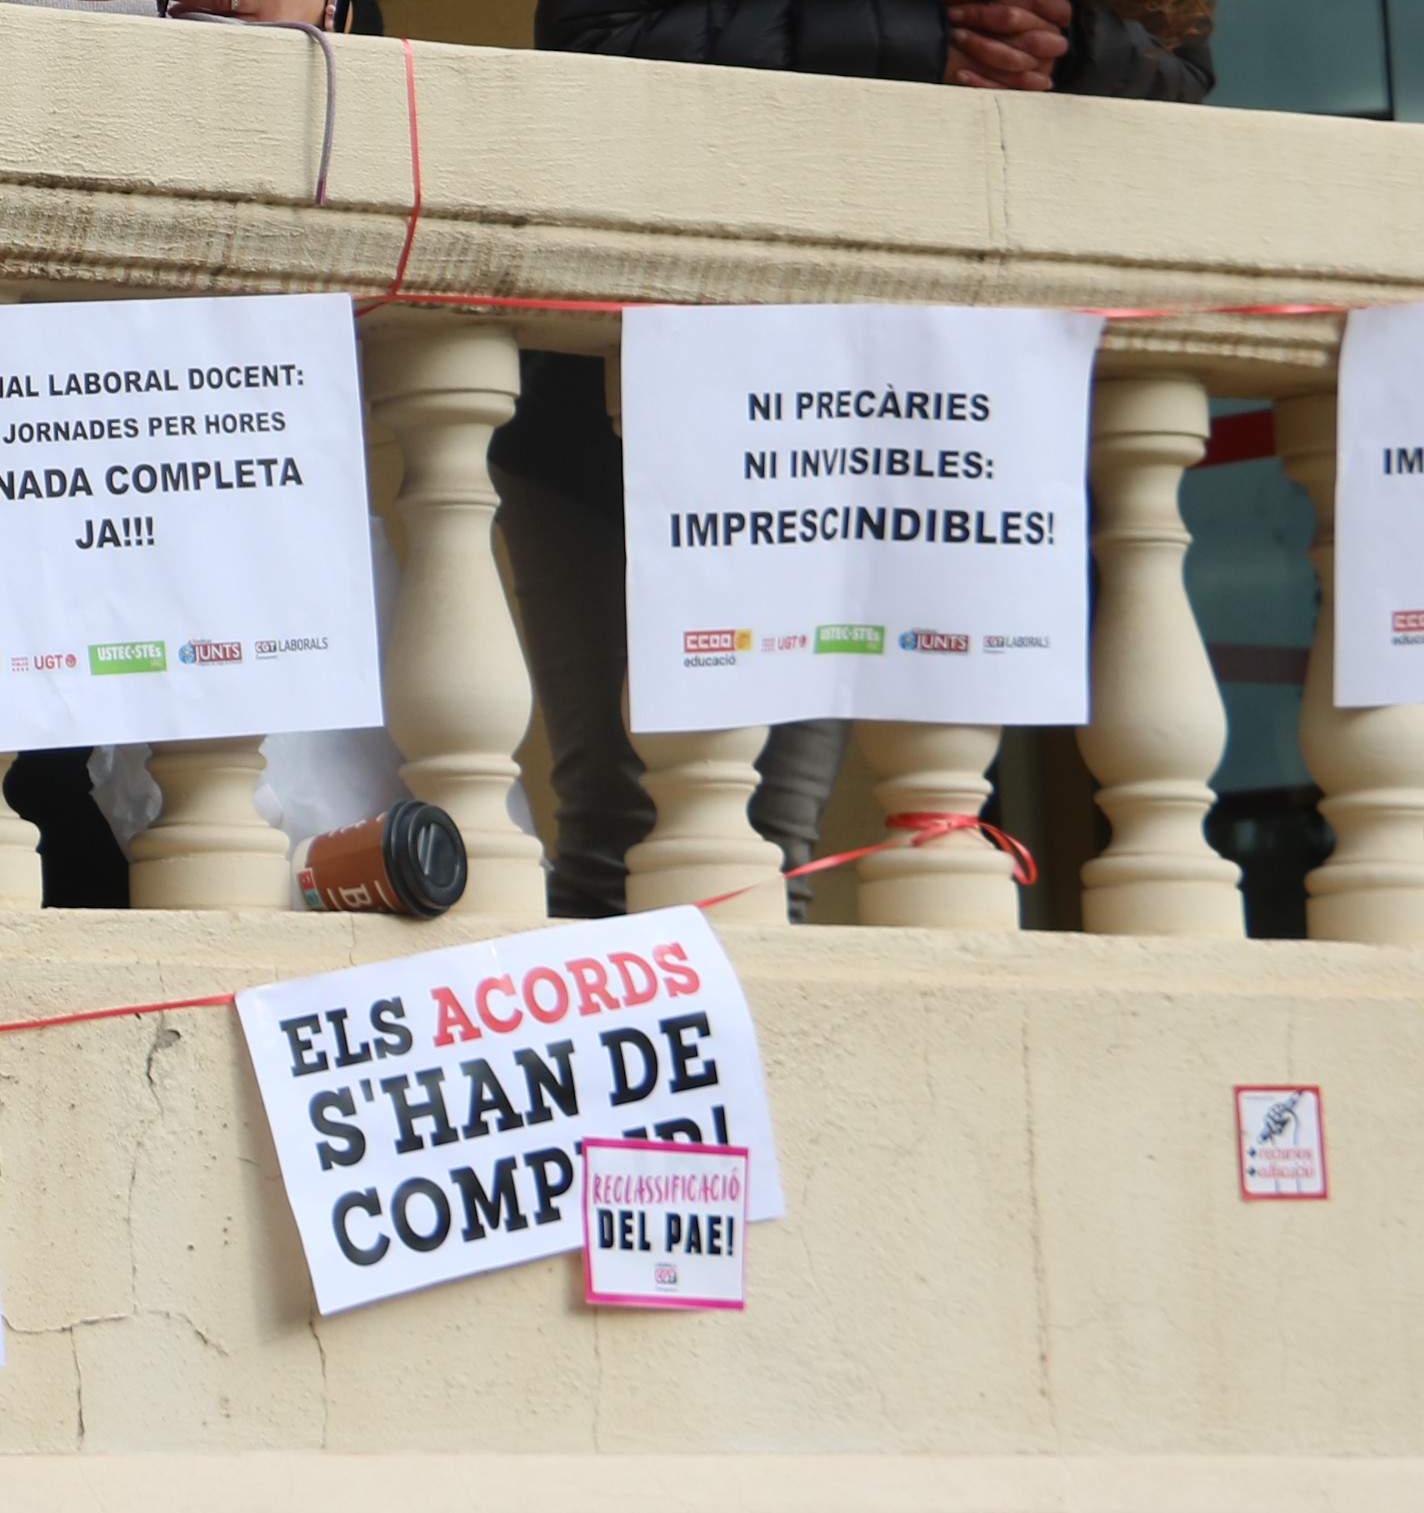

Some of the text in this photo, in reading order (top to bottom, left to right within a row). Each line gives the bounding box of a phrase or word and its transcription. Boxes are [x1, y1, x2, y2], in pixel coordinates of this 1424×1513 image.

[48, 368, 178, 396] LABORAL
[189, 364, 304, 391] DOCENT:
[749, 384, 990, 422] NI PRECÀRIES
[3, 418, 139, 445] JORNADES
[149, 415, 197, 438] PER
[205, 411, 286, 434] HORES
[106, 457, 303, 495] COMPLETA
[744, 447, 994, 480] NI INVISIBLES:
[75, 517, 155, 550] JA!!!
[671, 506, 1055, 547] IMPRESCINDIBLES!
[195, 644, 240, 663] JUNTS
[278, 637, 328, 652] LABORALS
[34, 655, 64, 670] UGT
[280, 942, 701, 1077] ELS ACORDS
[308, 1011, 719, 1171] S'HAN DE
[593, 1168, 739, 1205] RECLASSIFICACIÓ
[598, 1209, 735, 1256] DEL PAE!
